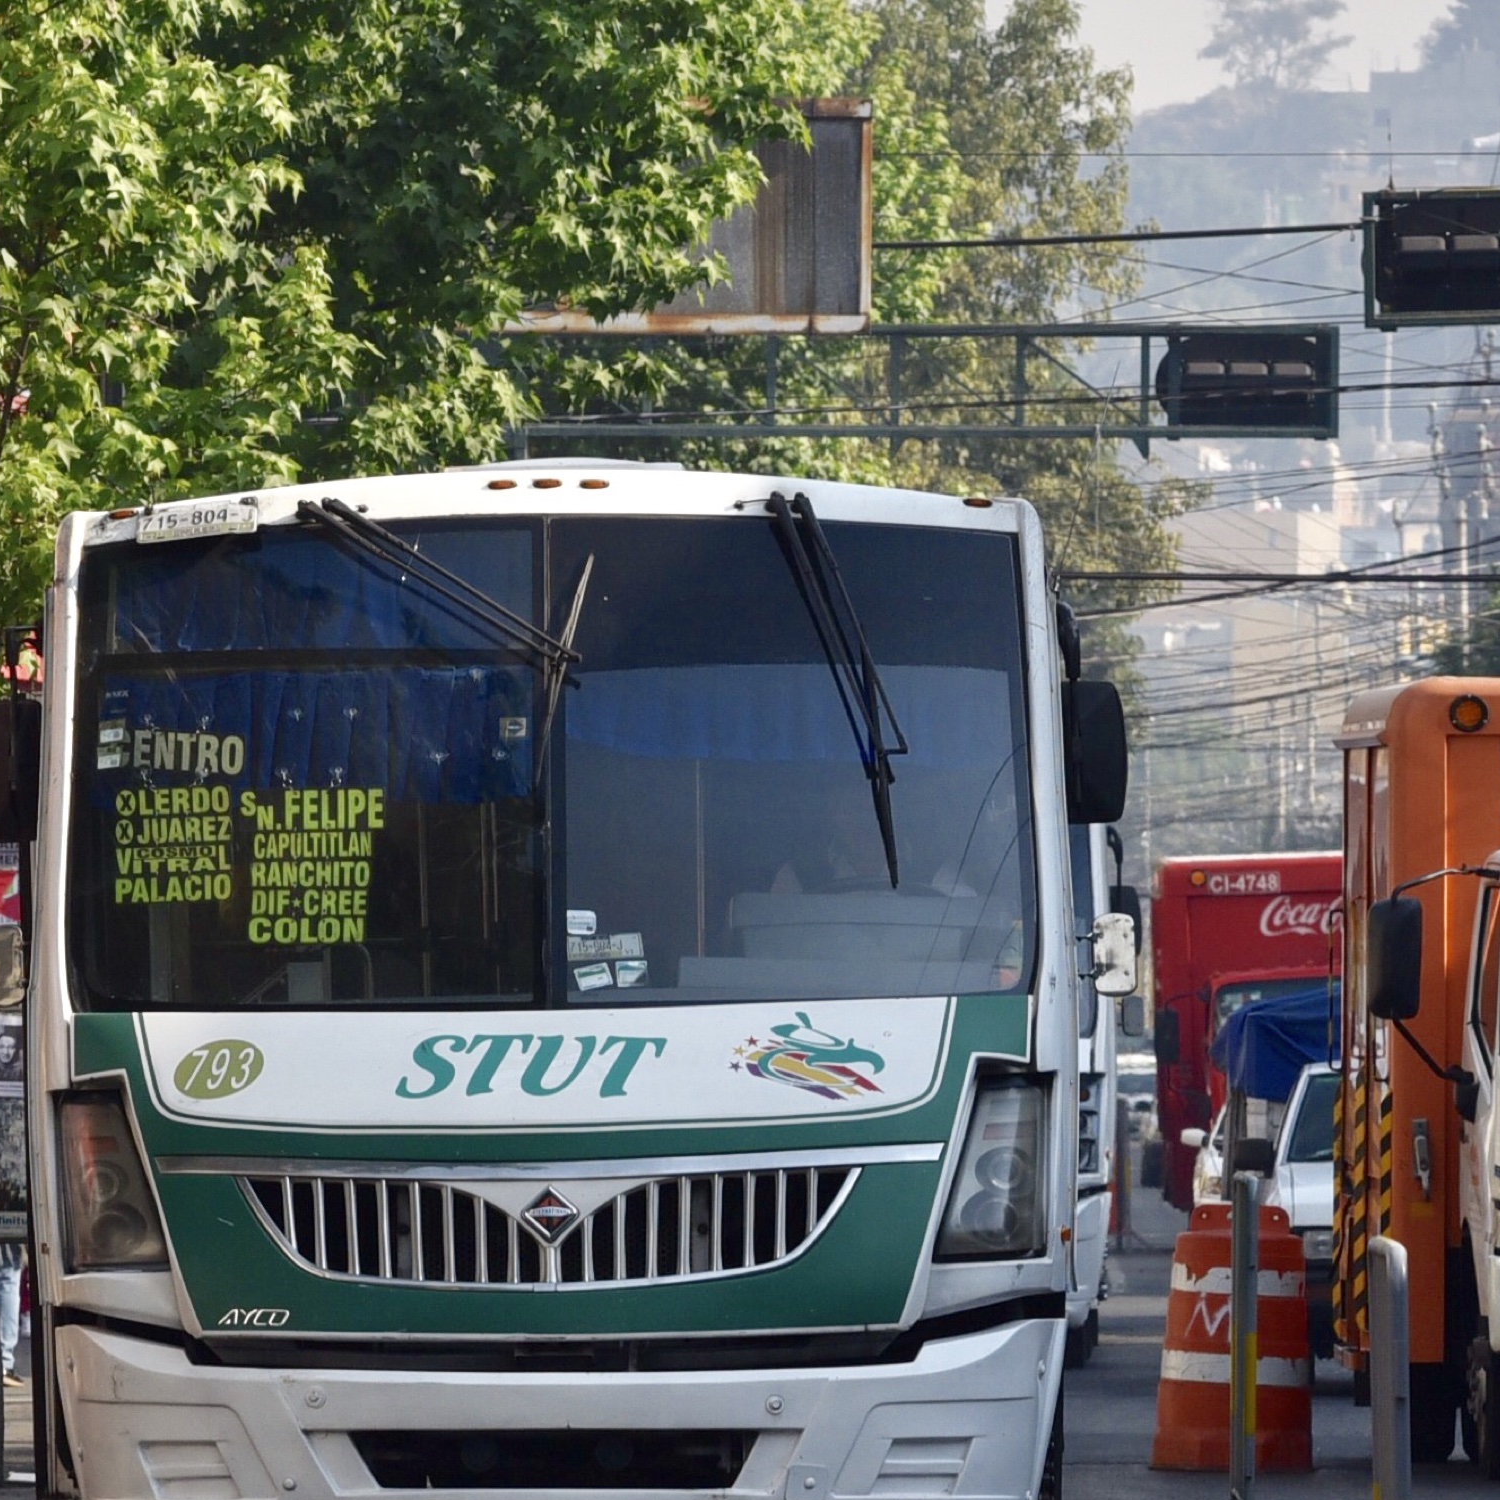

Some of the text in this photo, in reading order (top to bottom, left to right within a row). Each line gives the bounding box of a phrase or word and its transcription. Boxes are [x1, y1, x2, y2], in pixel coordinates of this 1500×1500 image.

[142, 508, 254, 531] 715-804-J
[138, 786, 230, 816] LERDO
[285, 788, 384, 830] FELIPE
[137, 816, 232, 844] JUAREZ
[115, 845, 232, 875] VITRAL
[136, 846, 215, 859] COSMO
[253, 832, 372, 860] CAPULTITLAN
[115, 873, 232, 904] PALACIO
[252, 861, 370, 888] RANCHITO
[303, 889, 368, 916] CREE
[248, 916, 365, 944] COLON
[183, 1047, 254, 1092] 793
[395, 1034, 668, 1099] STUT
